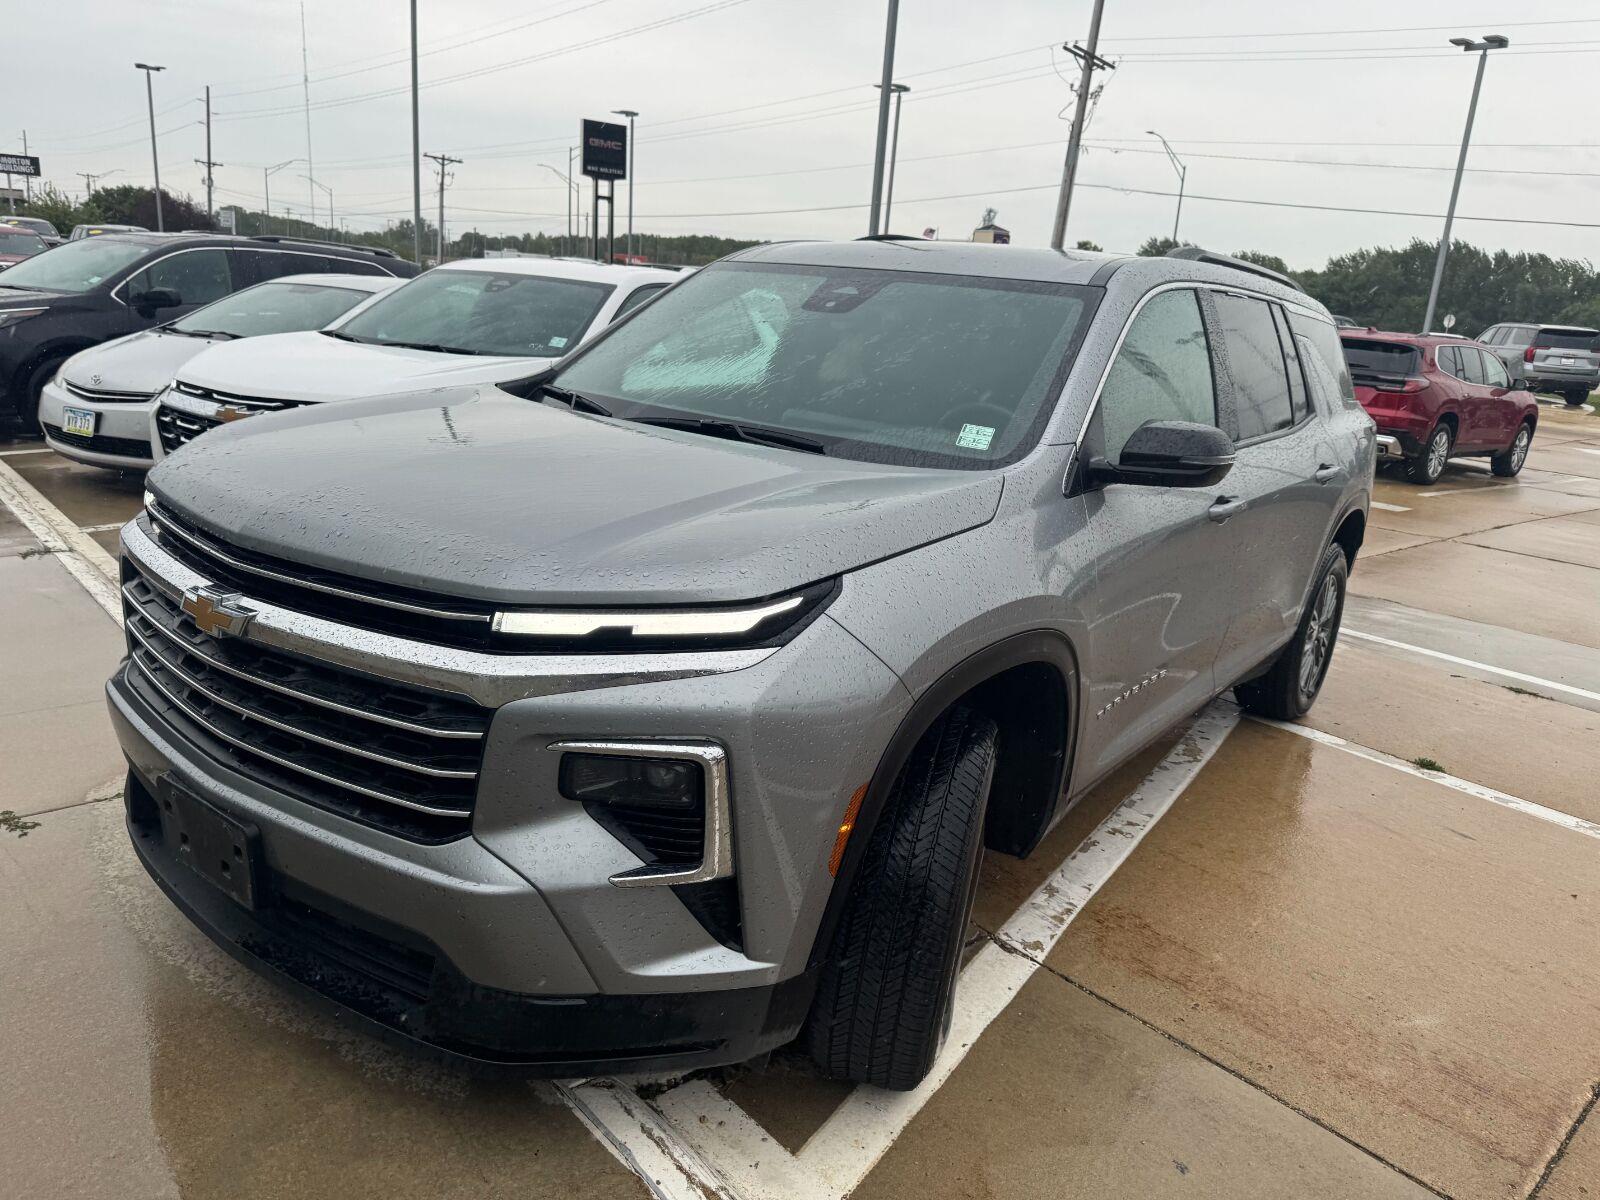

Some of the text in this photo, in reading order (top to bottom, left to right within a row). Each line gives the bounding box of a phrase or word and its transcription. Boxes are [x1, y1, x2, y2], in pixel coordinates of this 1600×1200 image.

[589, 138, 623, 150] GMC
[0, 156, 31, 166] MORTON
[0, 164, 35, 174] BUILDINGS
[1095, 669, 1167, 720] TRAVERSE
